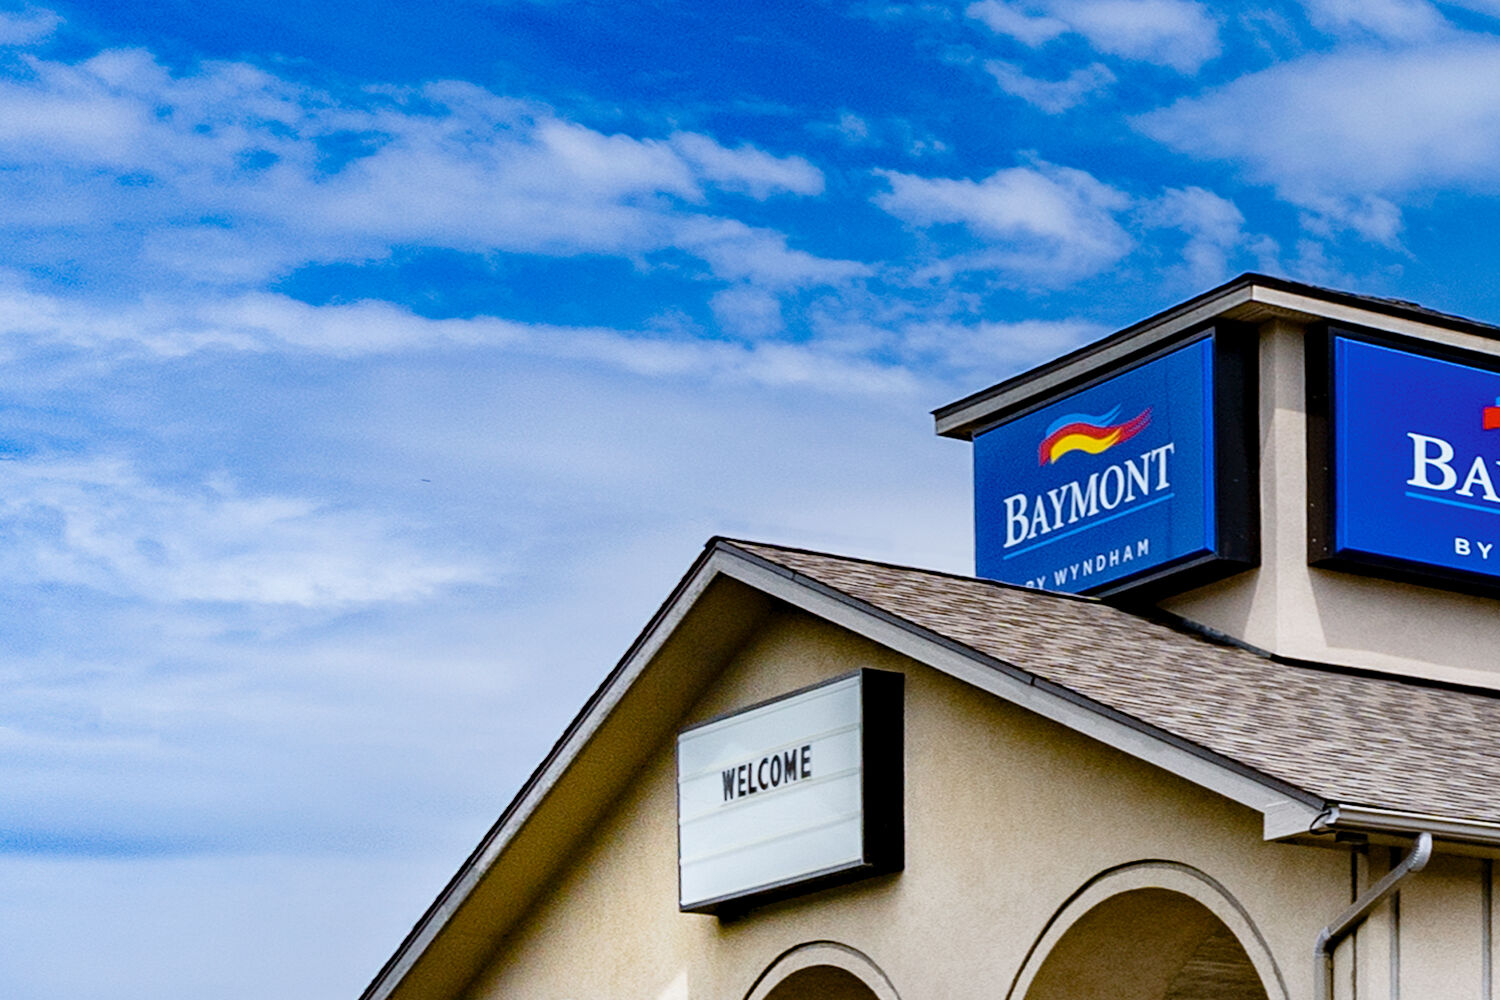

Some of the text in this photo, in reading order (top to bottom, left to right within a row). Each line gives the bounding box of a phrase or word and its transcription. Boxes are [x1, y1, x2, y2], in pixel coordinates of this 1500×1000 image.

[1003, 442, 1175, 548] BAYMONT
[1053, 538, 1149, 586] WYNDHAM
[1454, 538, 1493, 560] BY
[722, 744, 812, 801] WELCOME
